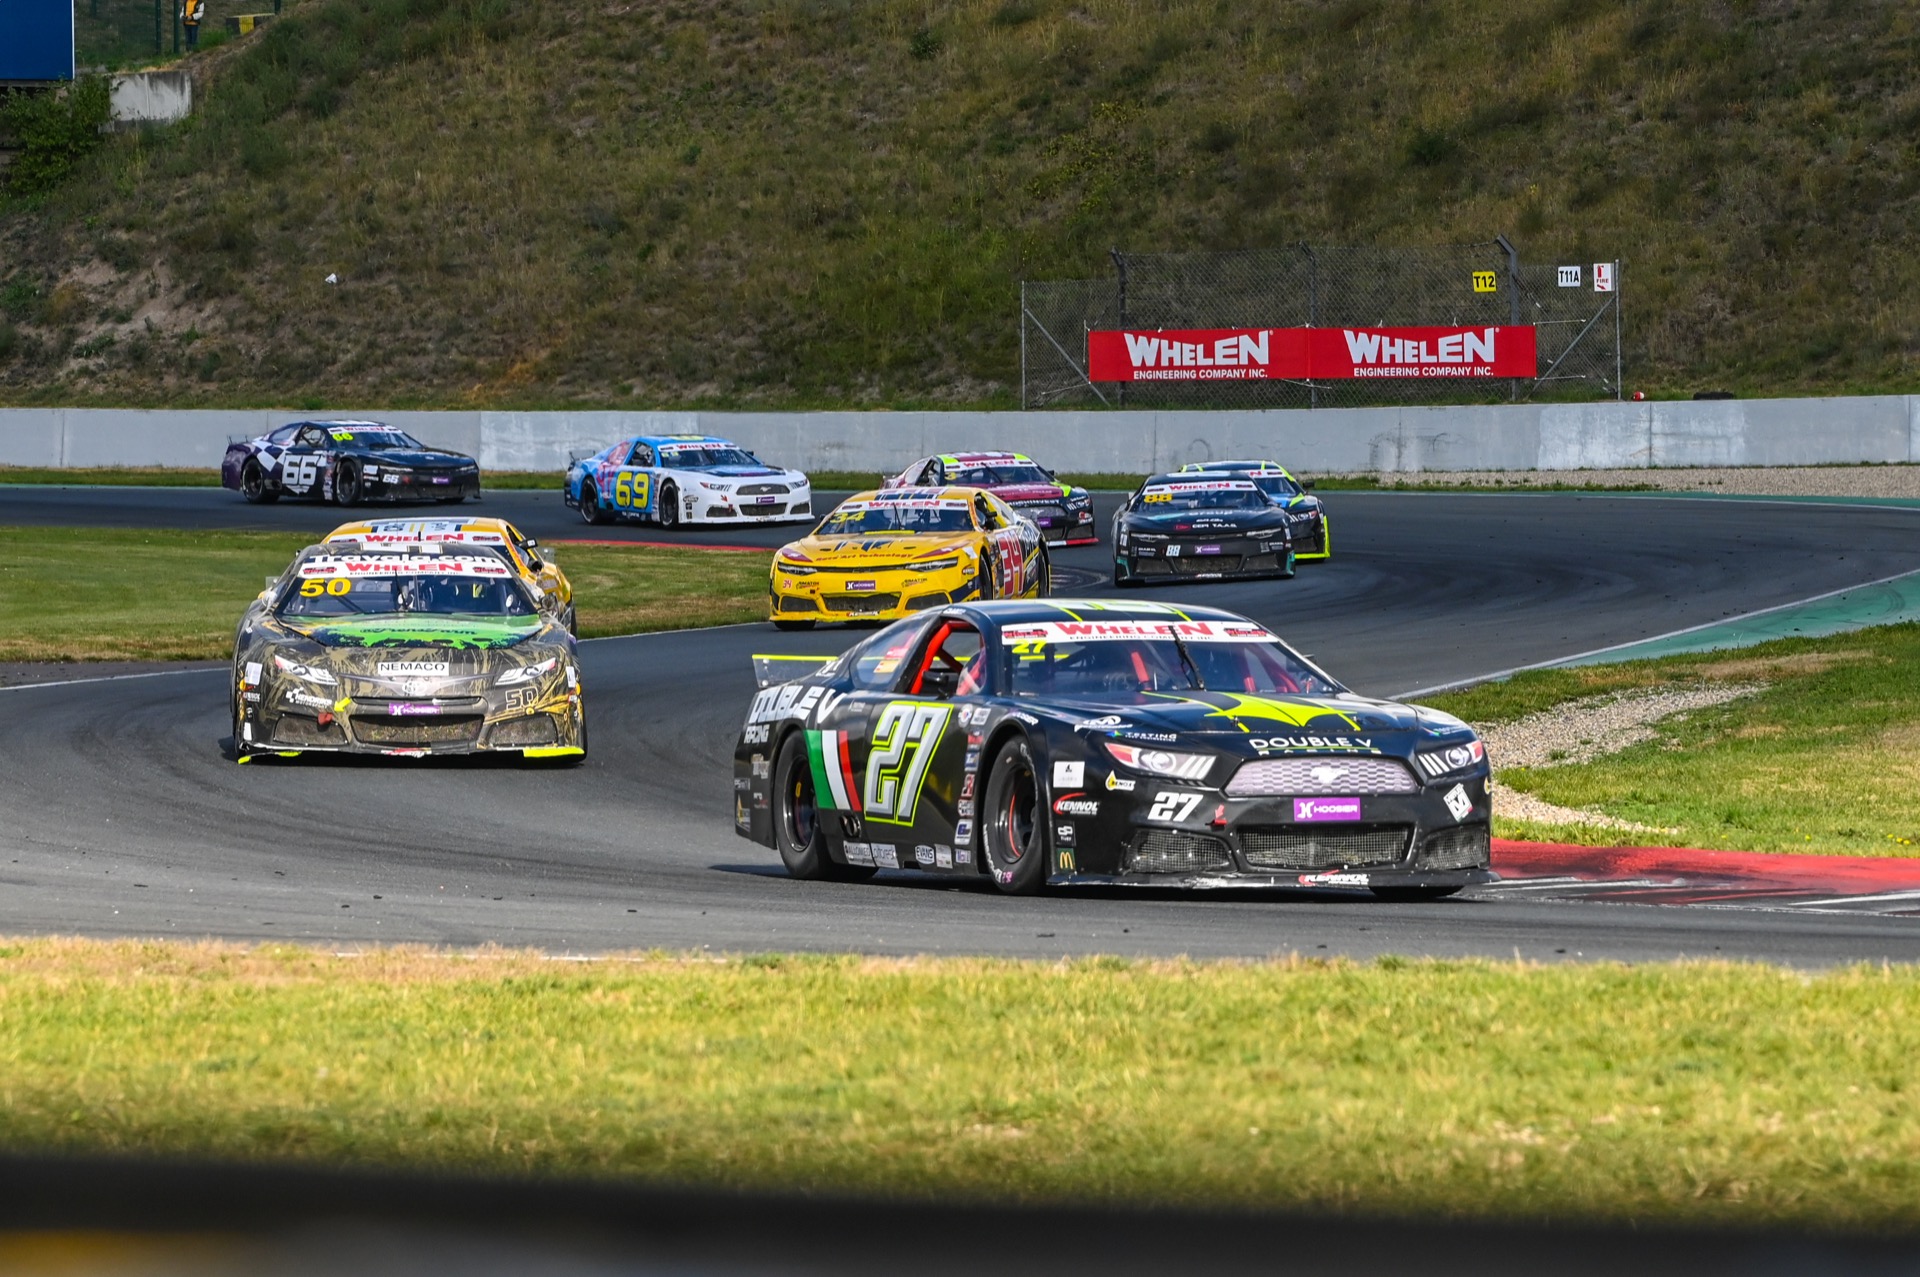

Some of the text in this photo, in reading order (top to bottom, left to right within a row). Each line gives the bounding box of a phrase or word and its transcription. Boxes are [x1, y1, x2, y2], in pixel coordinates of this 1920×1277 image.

[1473, 275, 1495, 288] T12
[1559, 270, 1580, 283] T11A
[1123, 330, 1269, 367] WHELEN
[1343, 327, 1495, 364] WHELEN
[1133, 368, 1268, 379] ENGINEERING COMPANY INC.
[1353, 366, 1494, 377] ENGINEERING COMPANY INC.
[281, 455, 322, 486] 66
[382, 474, 400, 485] 66
[615, 471, 650, 510] 69
[1168, 482, 1231, 491] WHELEN
[1143, 494, 1173, 503] 88
[829, 511, 866, 524] 34
[364, 533, 464, 543] WHELEN
[1165, 545, 1181, 557] 88
[345, 563, 463, 571] WHELEN
[300, 577, 352, 598] 50
[782, 580, 792, 589] 34
[1053, 622, 1214, 636] WHELEN
[1011, 640, 1047, 654] 27
[380, 663, 446, 672] NEMACO
[505, 687, 539, 709] 50
[816, 688, 848, 724] V
[1249, 737, 1371, 749] DOUBLE V
[864, 701, 954, 827] 27
[1057, 801, 1099, 812] KENNOL
[1147, 791, 1204, 822] 27
[1313, 804, 1358, 813] HOOSIER
